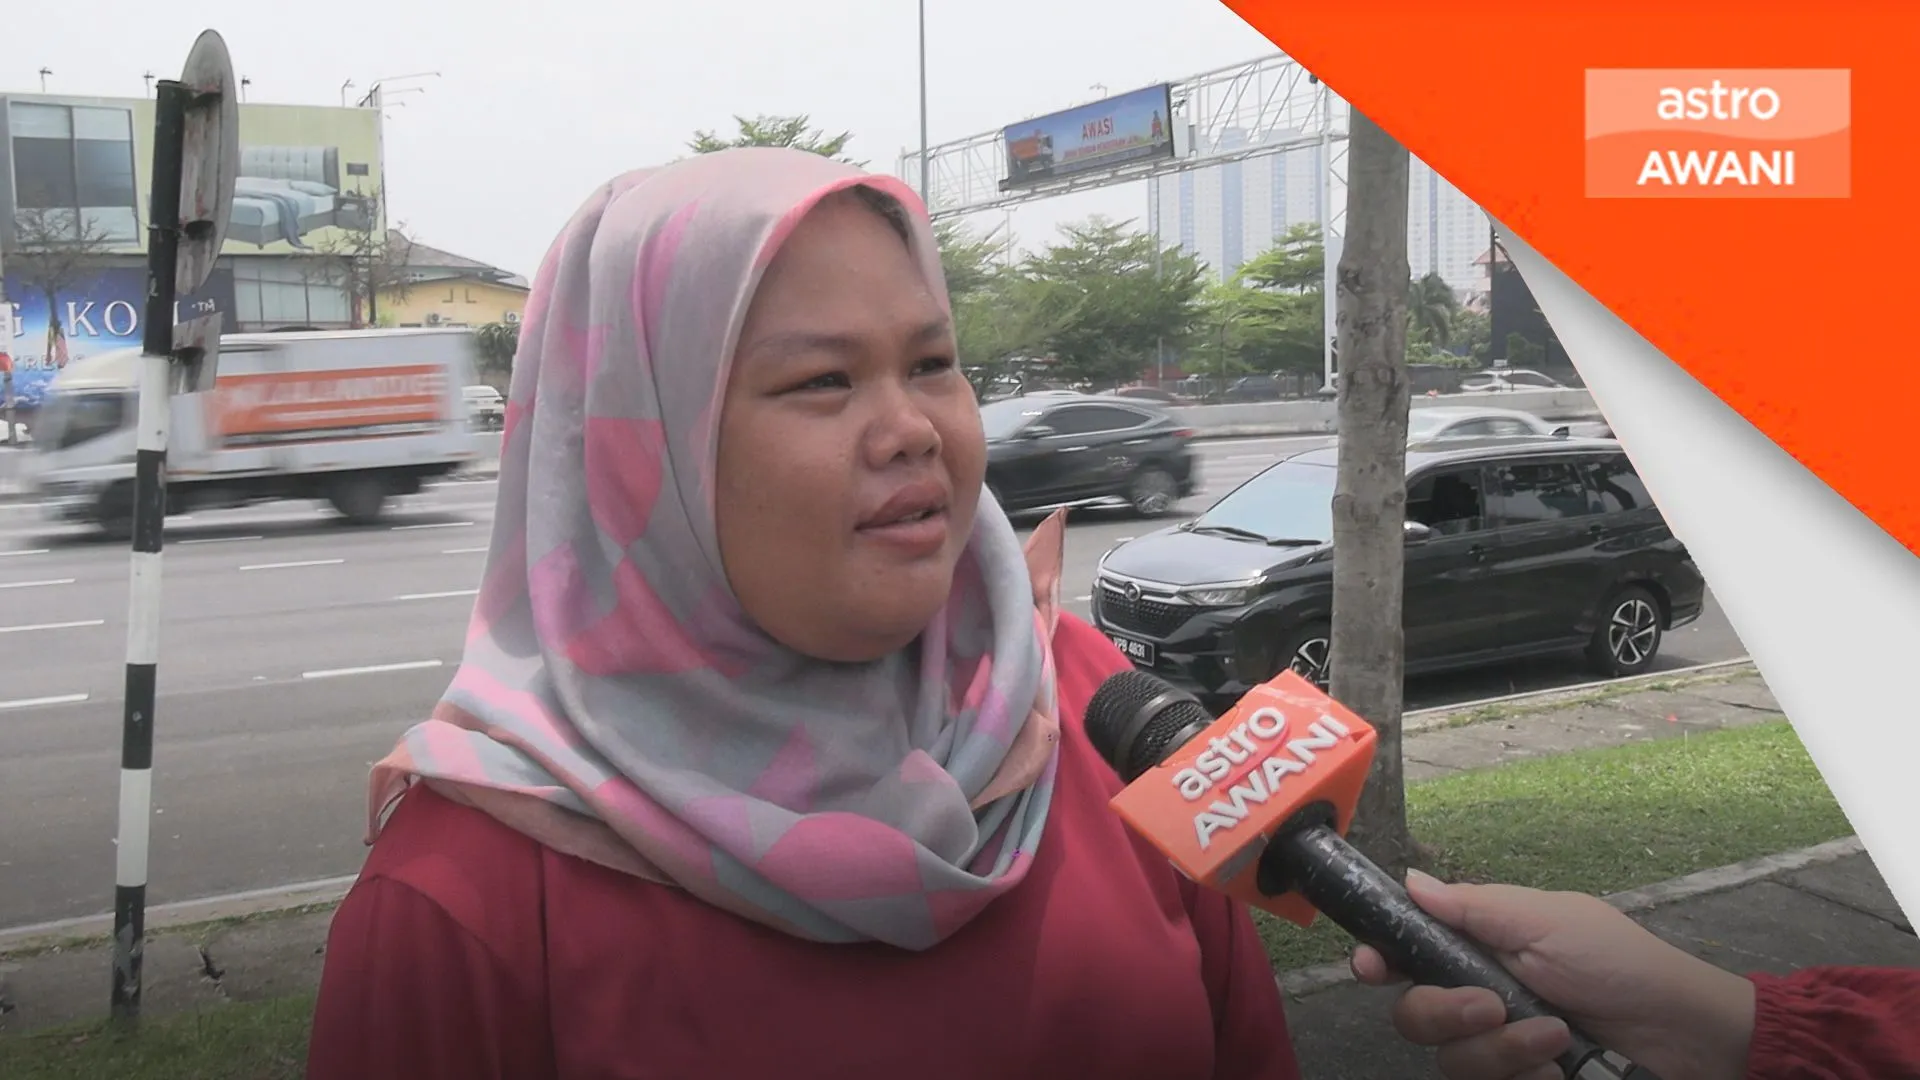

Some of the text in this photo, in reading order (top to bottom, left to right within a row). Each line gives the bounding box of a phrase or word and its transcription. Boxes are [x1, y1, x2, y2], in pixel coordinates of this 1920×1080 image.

[1081, 116, 1114, 140] AWASI
[1171, 706, 1287, 802] astro
[1193, 714, 1350, 849] AWANI
